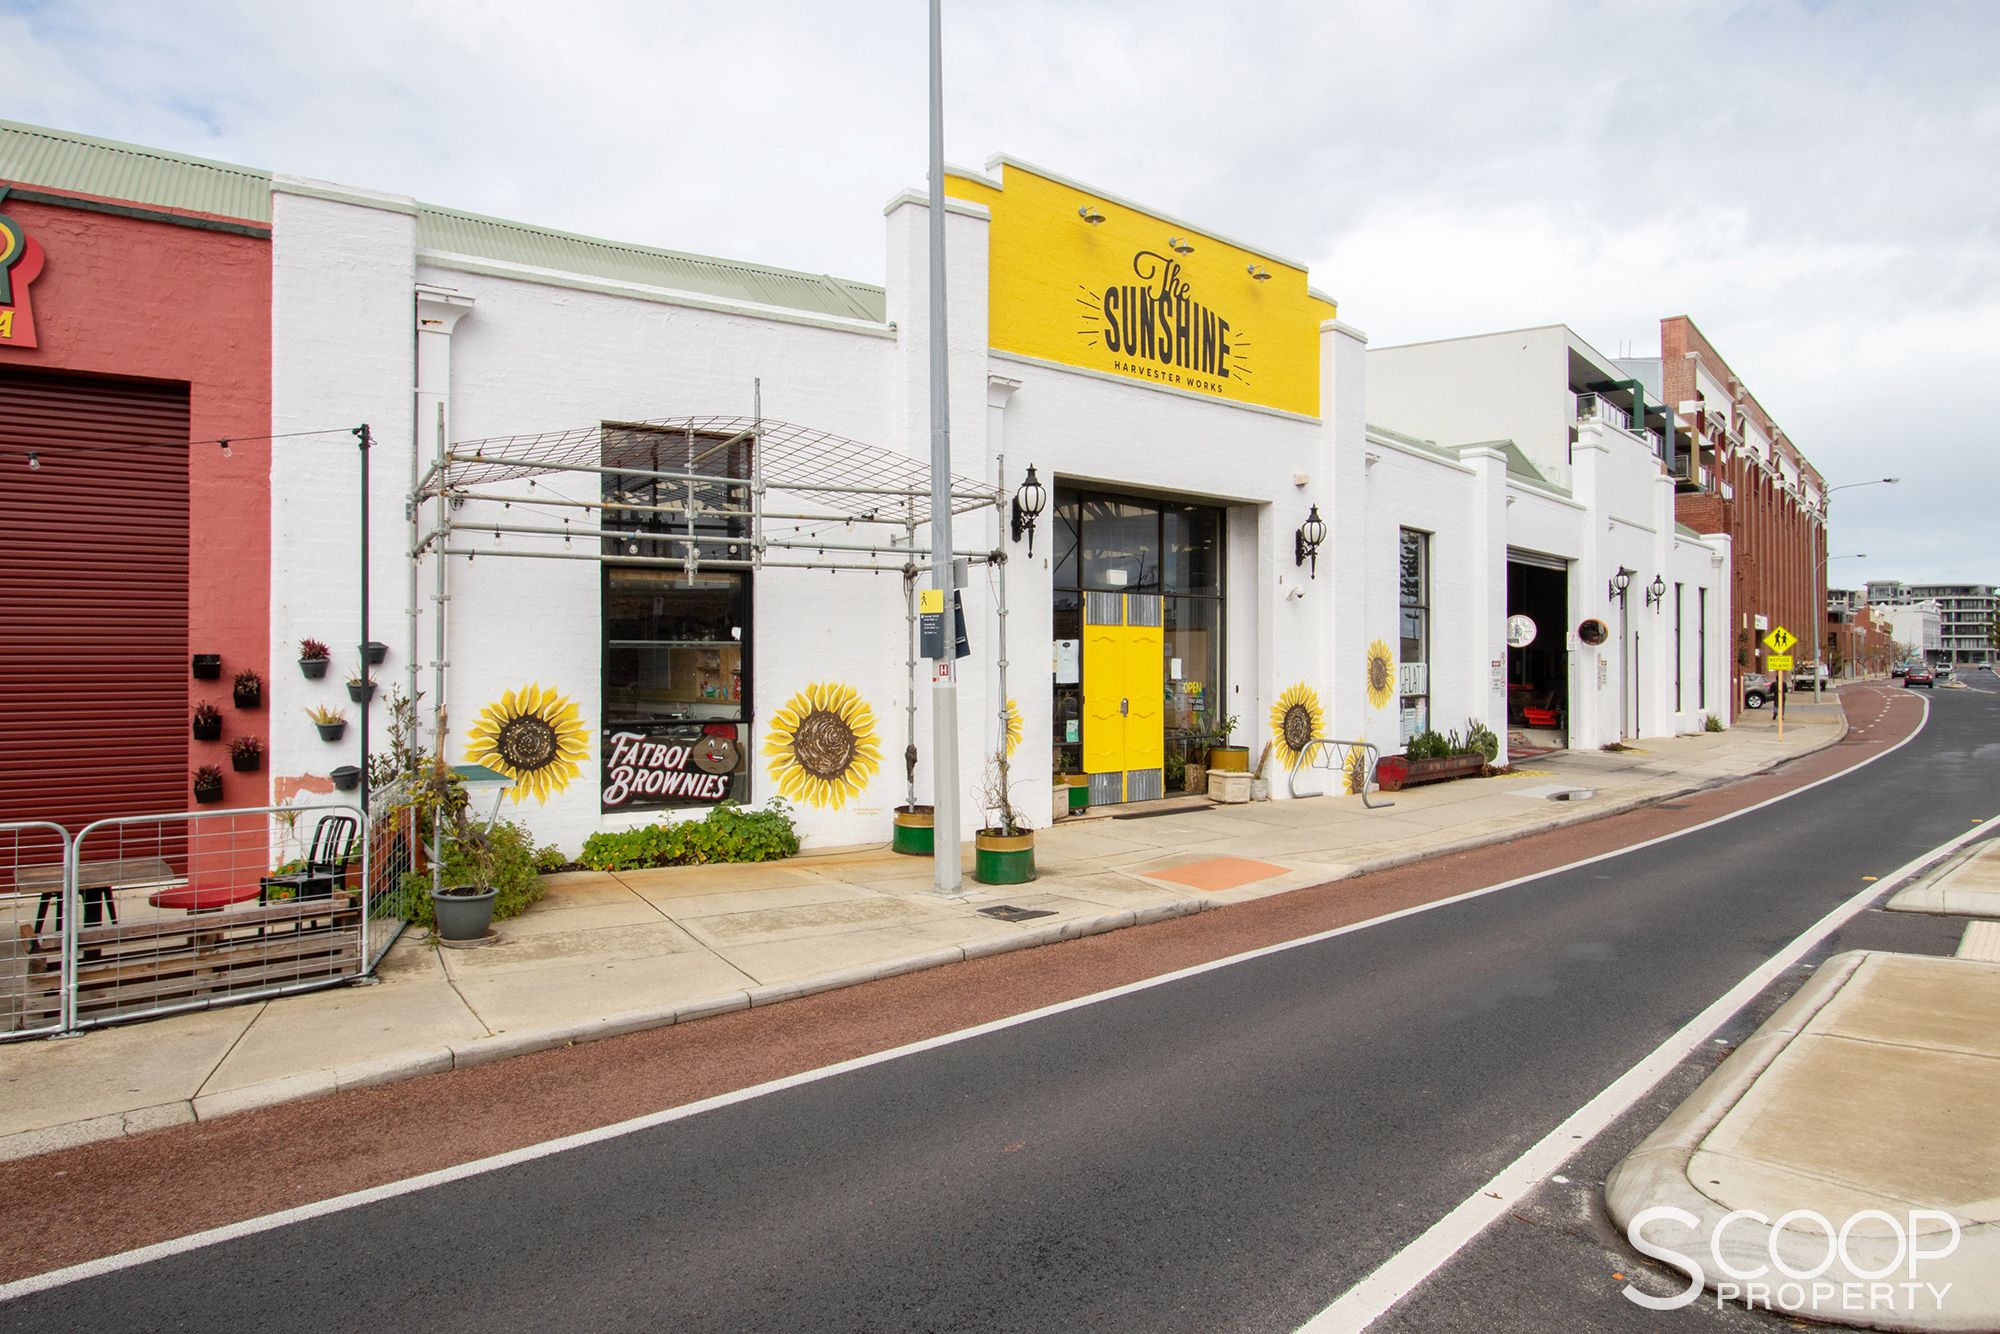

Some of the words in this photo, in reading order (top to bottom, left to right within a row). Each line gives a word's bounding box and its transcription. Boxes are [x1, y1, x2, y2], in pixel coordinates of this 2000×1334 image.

[1133, 250, 1191, 300] The
[1104, 286, 1231, 378] SUNSHINE
[1114, 360, 1181, 382] HARVESTER
[1186, 376, 1223, 393] WORKS
[940, 665, 948, 676] H
[1183, 681, 1201, 693] OPEN
[1400, 665, 1426, 694] GELATO
[607, 731, 691, 769] FATBOI
[602, 765, 729, 805] BROWNIES
